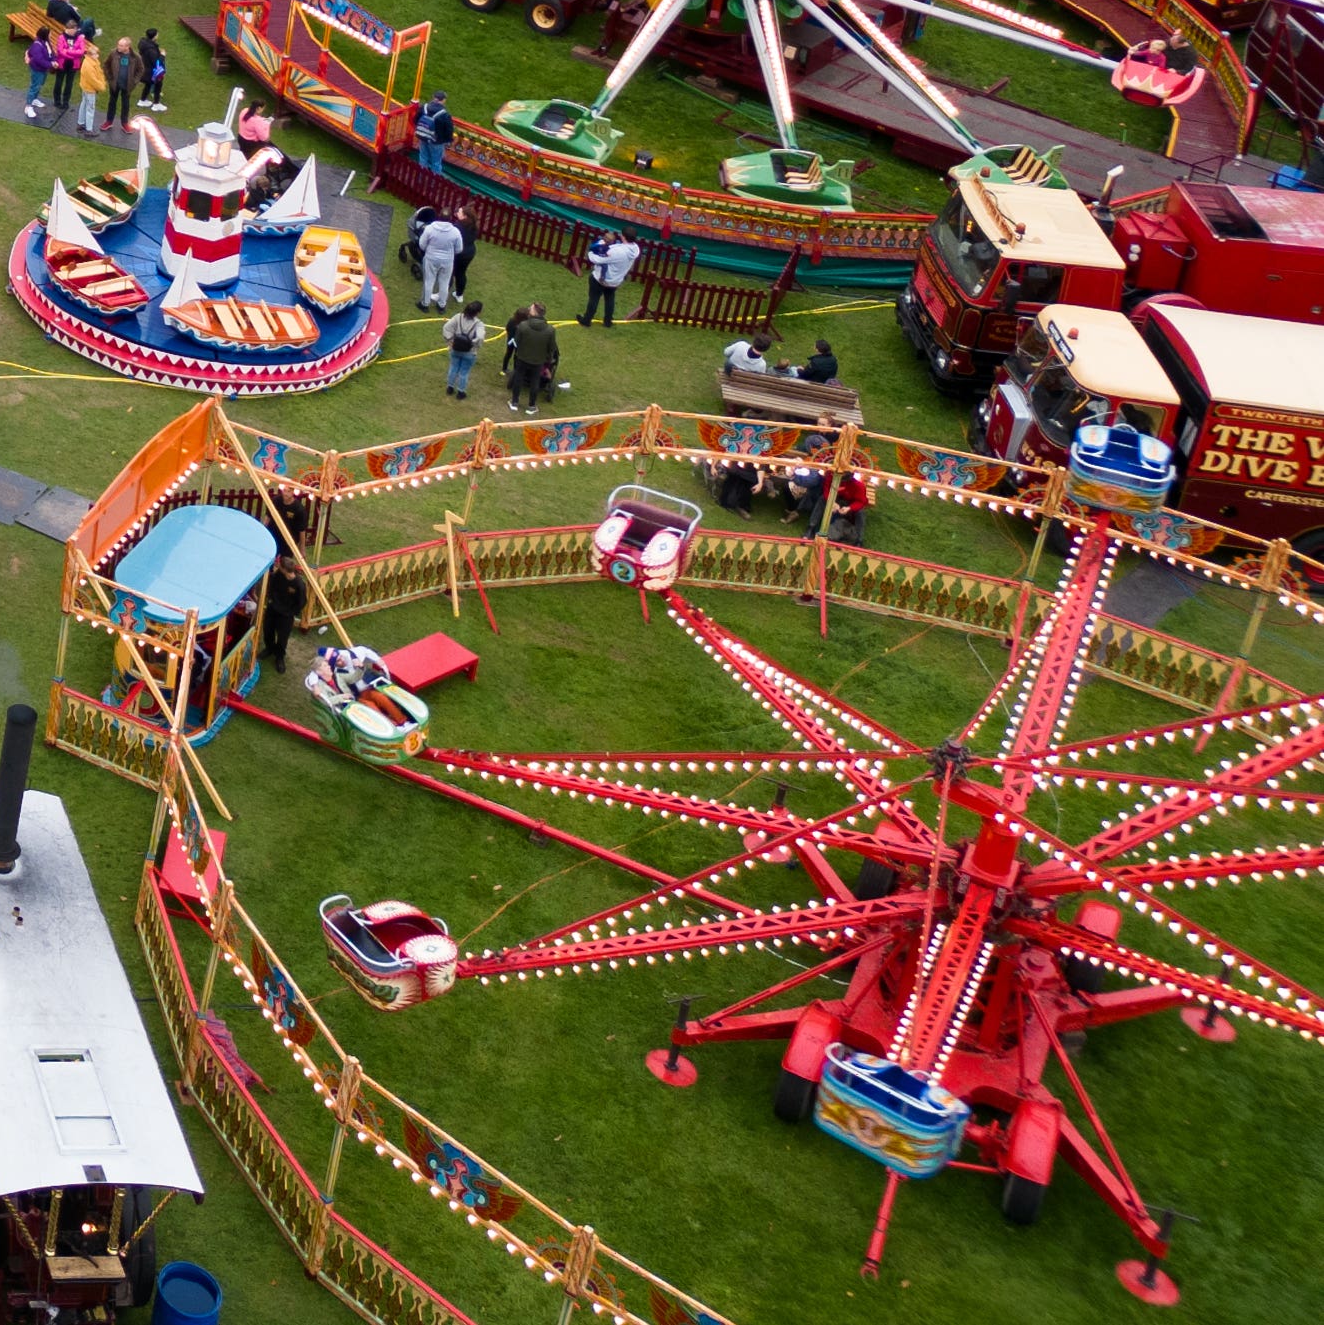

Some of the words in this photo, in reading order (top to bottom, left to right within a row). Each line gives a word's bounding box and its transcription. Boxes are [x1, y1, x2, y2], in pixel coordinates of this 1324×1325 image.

[335, 2, 389, 43] JETS
[1211, 424, 1295, 456] THE
[1198, 450, 1300, 484] DIVE
